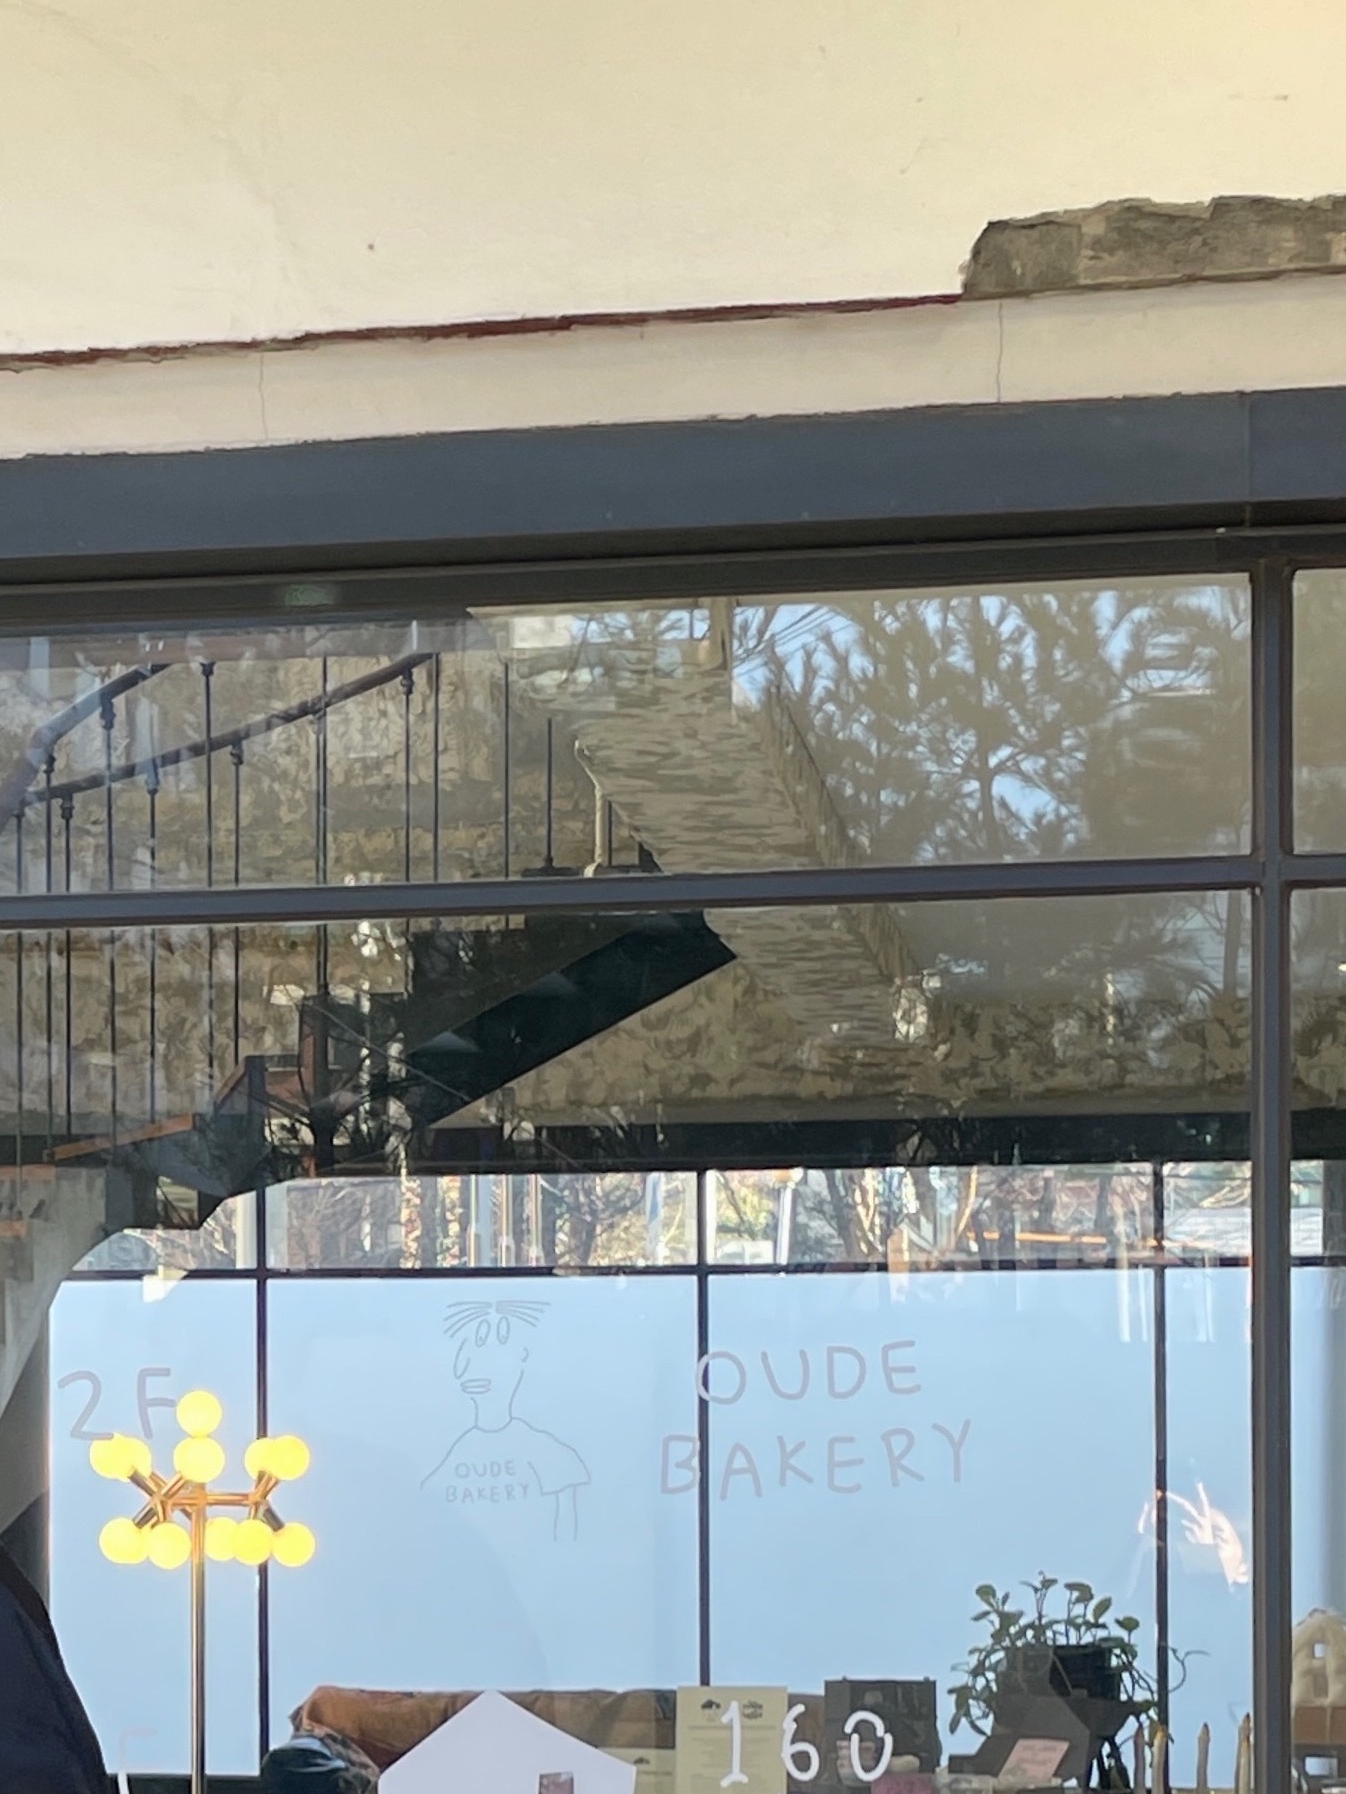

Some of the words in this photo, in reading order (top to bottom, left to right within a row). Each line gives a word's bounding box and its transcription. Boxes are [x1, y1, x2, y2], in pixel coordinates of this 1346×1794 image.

[695, 1340, 923, 1404] OUDE
[454, 1458, 516, 1478] OUDE
[660, 1419, 972, 1500] BAKERY
[445, 1482, 530, 1504] BAKERY
[720, 1700, 894, 1788] 160
